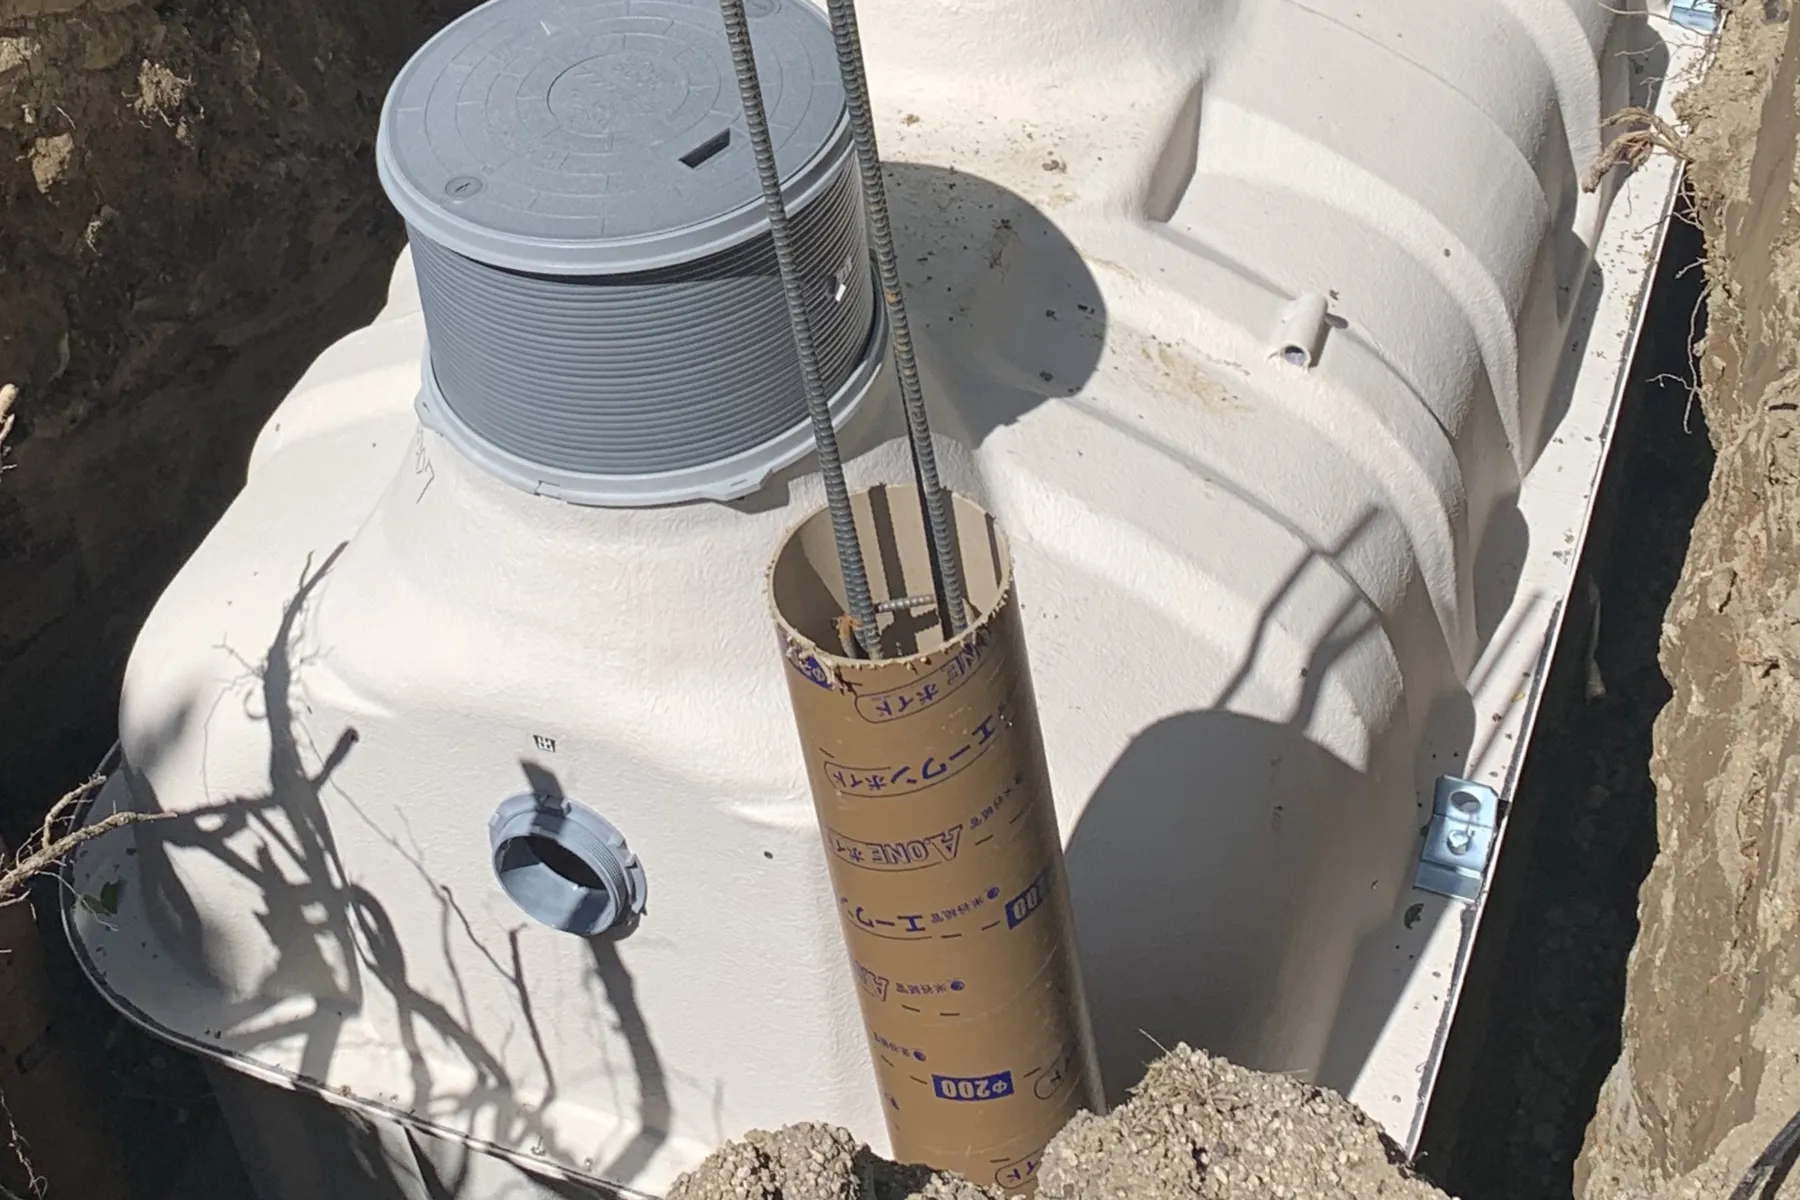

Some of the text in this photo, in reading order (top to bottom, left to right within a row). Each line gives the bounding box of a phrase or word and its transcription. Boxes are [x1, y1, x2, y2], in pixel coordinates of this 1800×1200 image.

[876, 684, 938, 717] ボイド
[833, 715, 994, 790] エーワンボイド
